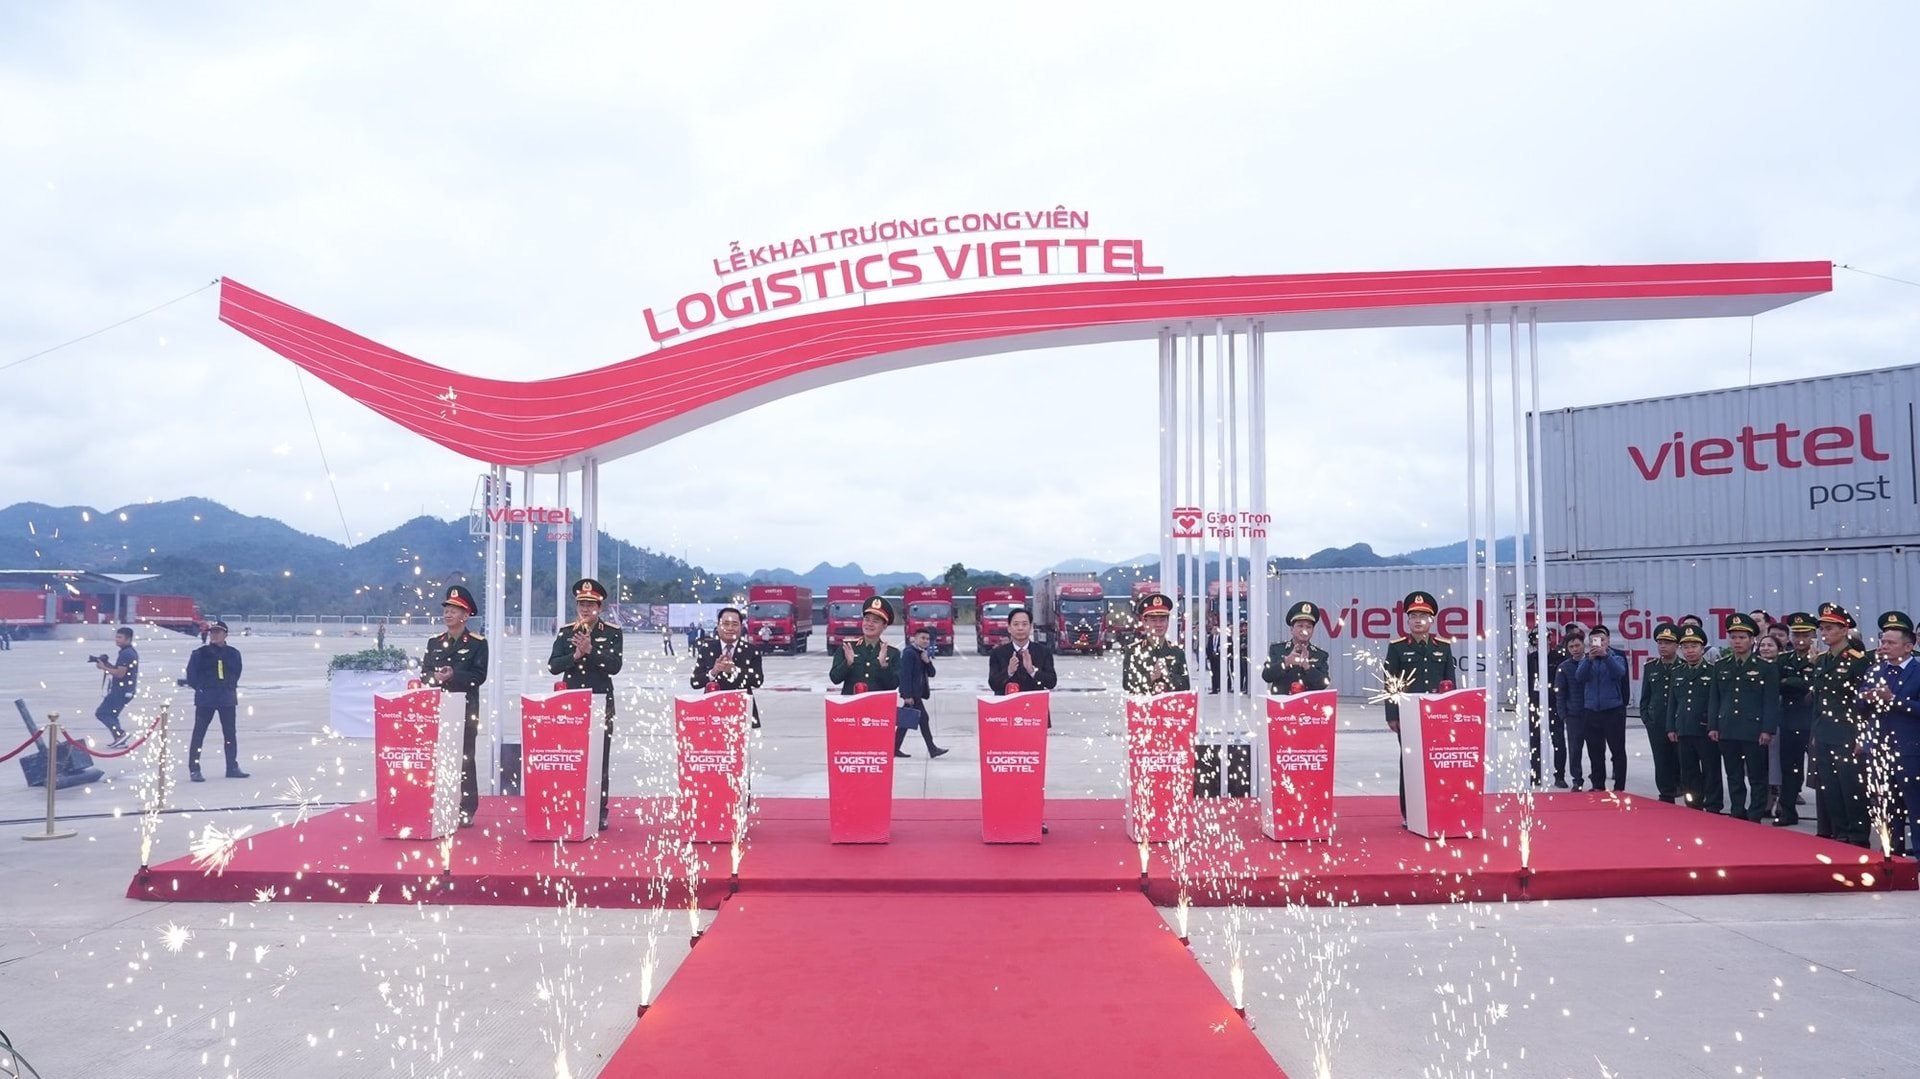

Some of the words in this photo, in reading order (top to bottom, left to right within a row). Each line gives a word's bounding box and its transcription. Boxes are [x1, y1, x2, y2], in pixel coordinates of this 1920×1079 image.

[713, 240, 748, 276] LỄ
[749, 235, 818, 267] KHAI
[820, 217, 938, 250] TRƯƠNG
[1024, 204, 1089, 229] VIÊN
[643, 248, 923, 342] LOGISTICS
[933, 239, 1164, 280] VIETTEL
[1627, 413, 1890, 481] viettel
[1809, 474, 1891, 510] post
[485, 506, 573, 524] viettel
[1206, 511, 1237, 524] Giao
[1239, 511, 1272, 526] Trọn
[1207, 526, 1235, 538] Trái
[1239, 526, 1267, 538] Tim
[1319, 598, 1487, 640] vietel
[381, 751, 431, 761] LOGISTICS
[530, 753, 582, 763] LOGISTICS
[833, 756, 888, 765] LOGISTICS
[986, 756, 1040, 765] LOGISTICS
[1276, 754, 1328, 763] LOGISTICS
[1429, 751, 1479, 760] LOGISTICS
[534, 762, 577, 771] VIETTEL
[838, 765, 884, 773] VIETTEL
[991, 764, 1035, 773] VIETTEL
[1280, 762, 1324, 771] VIETTEL
[1433, 760, 1475, 769] VIETTEL
